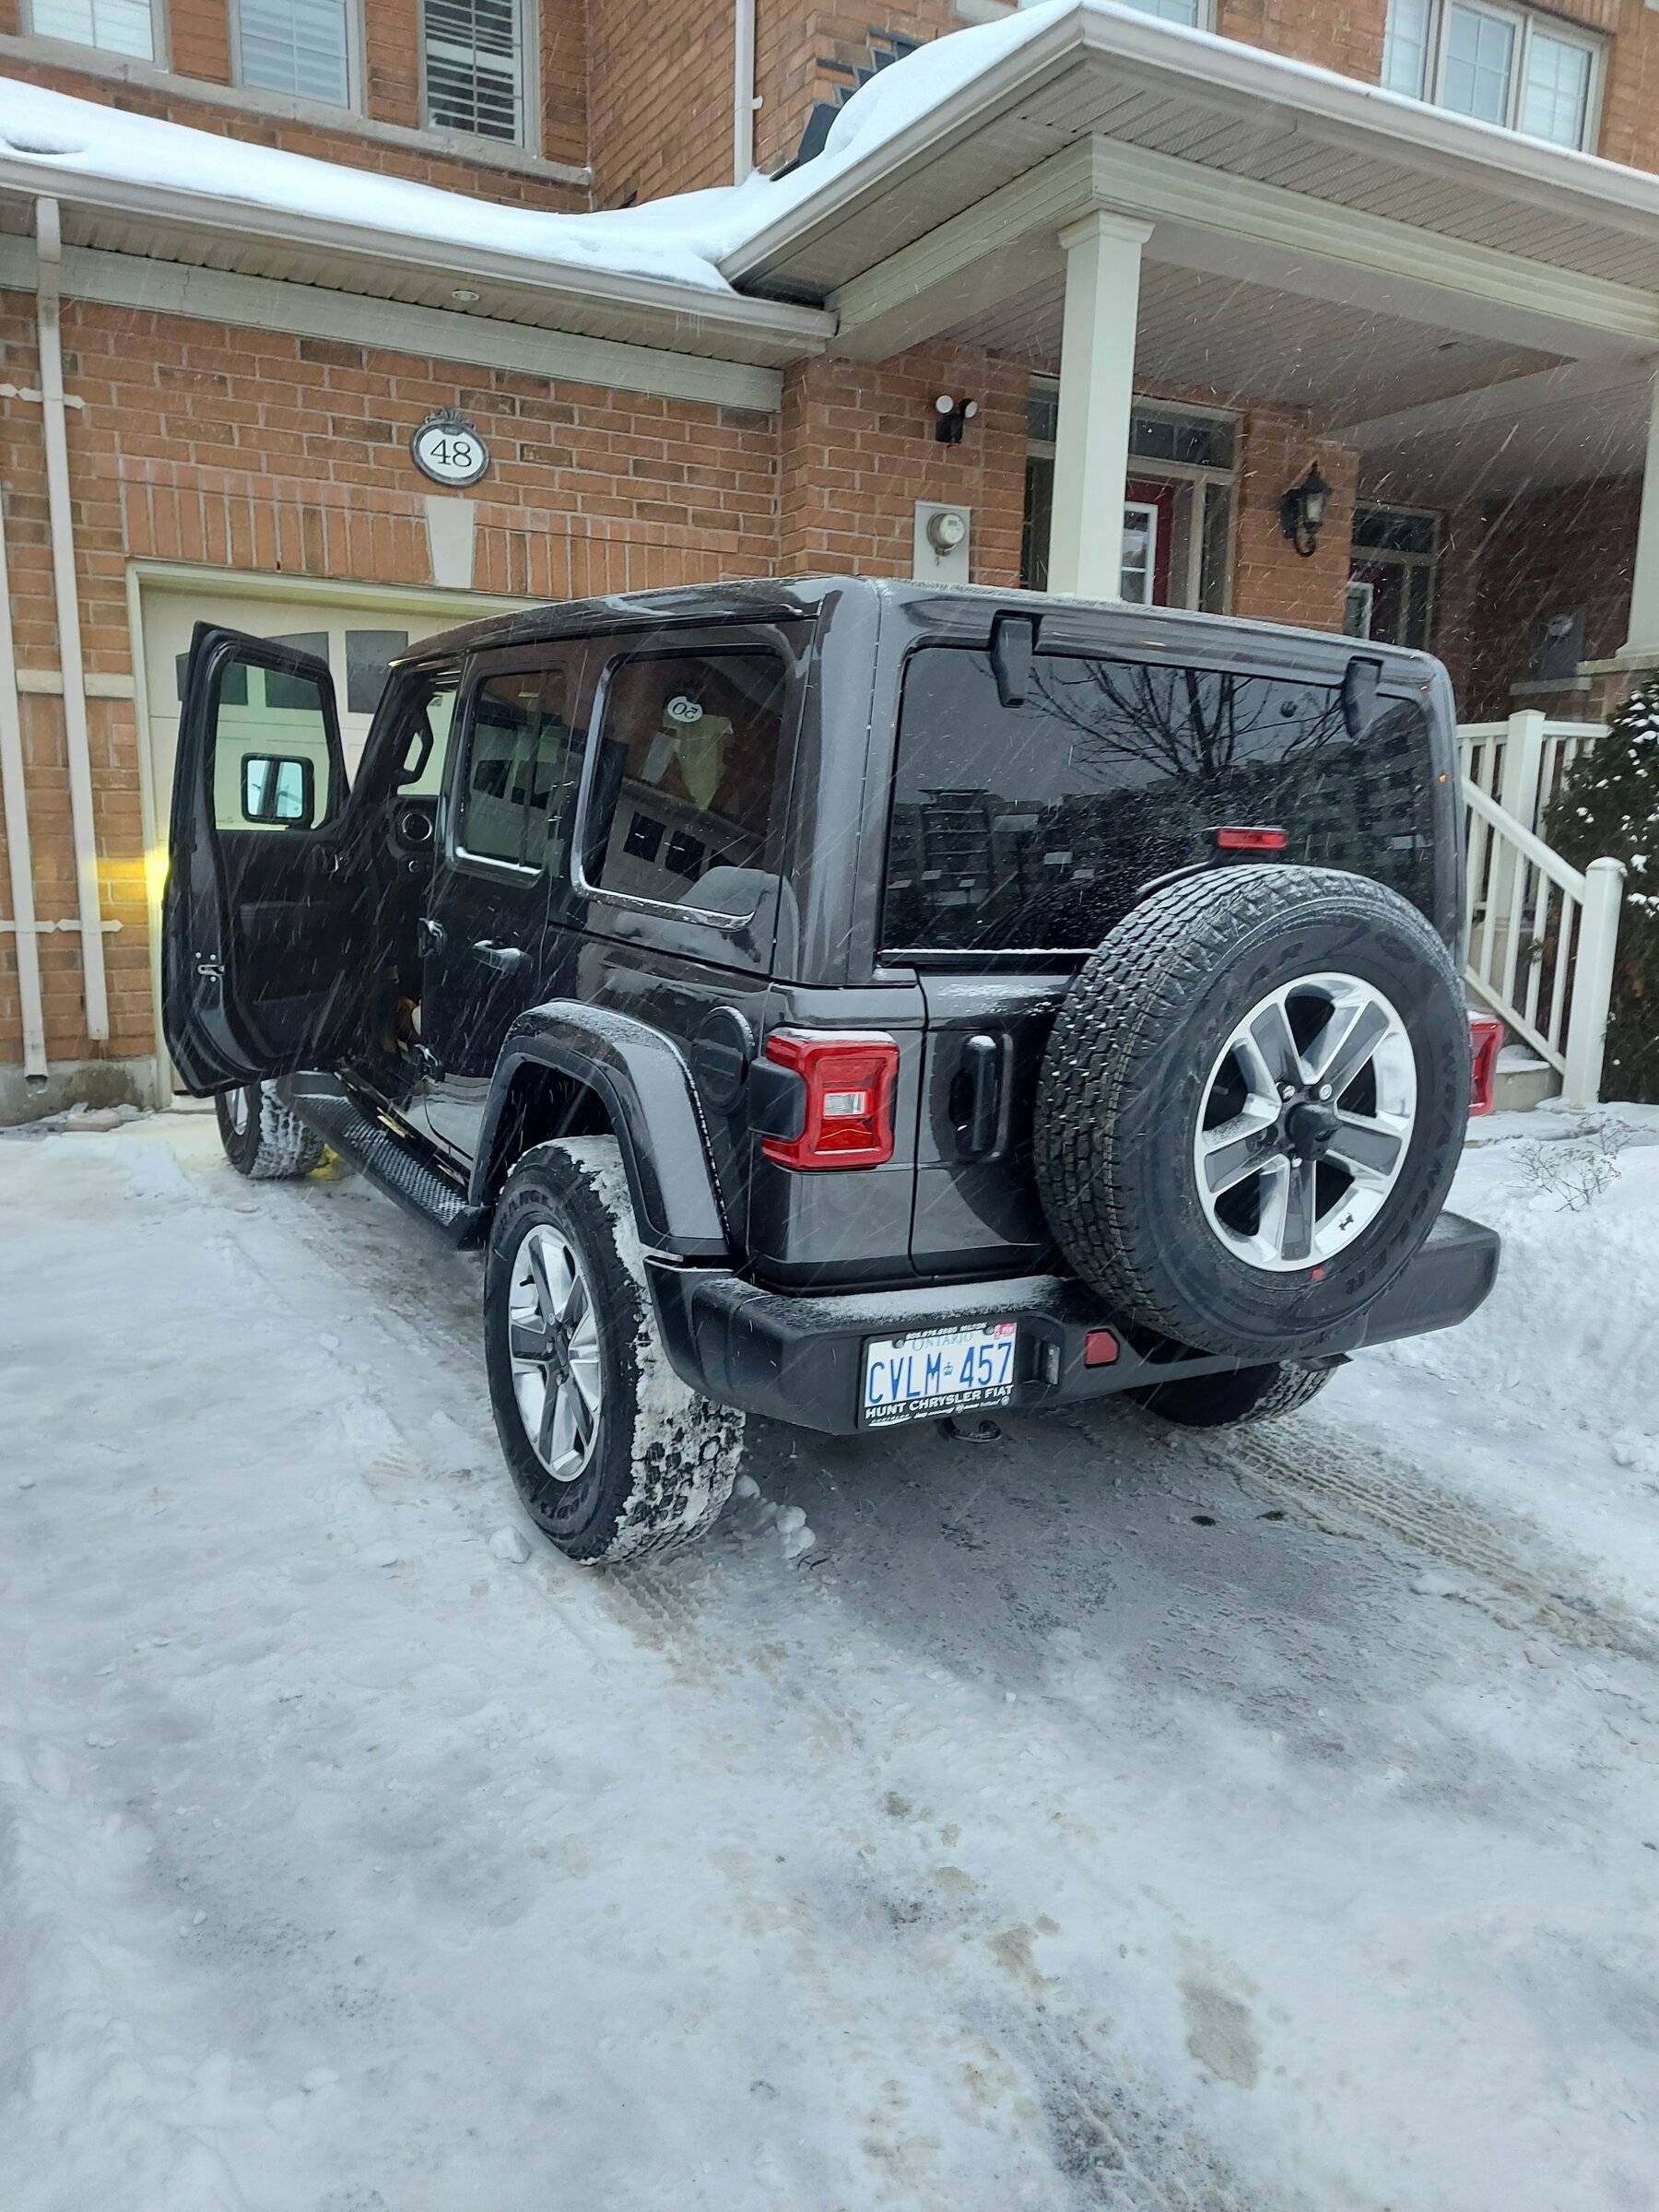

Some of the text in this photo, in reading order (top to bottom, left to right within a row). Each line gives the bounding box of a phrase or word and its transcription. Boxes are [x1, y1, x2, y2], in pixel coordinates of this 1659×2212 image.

[429, 439, 472, 467] 48
[869, 1341, 1013, 1404] CVLM 457
[865, 1402, 906, 1418] HUNT
[909, 1390, 982, 1412] CHRYSLER
[982, 1384, 1014, 1398] FIAT
